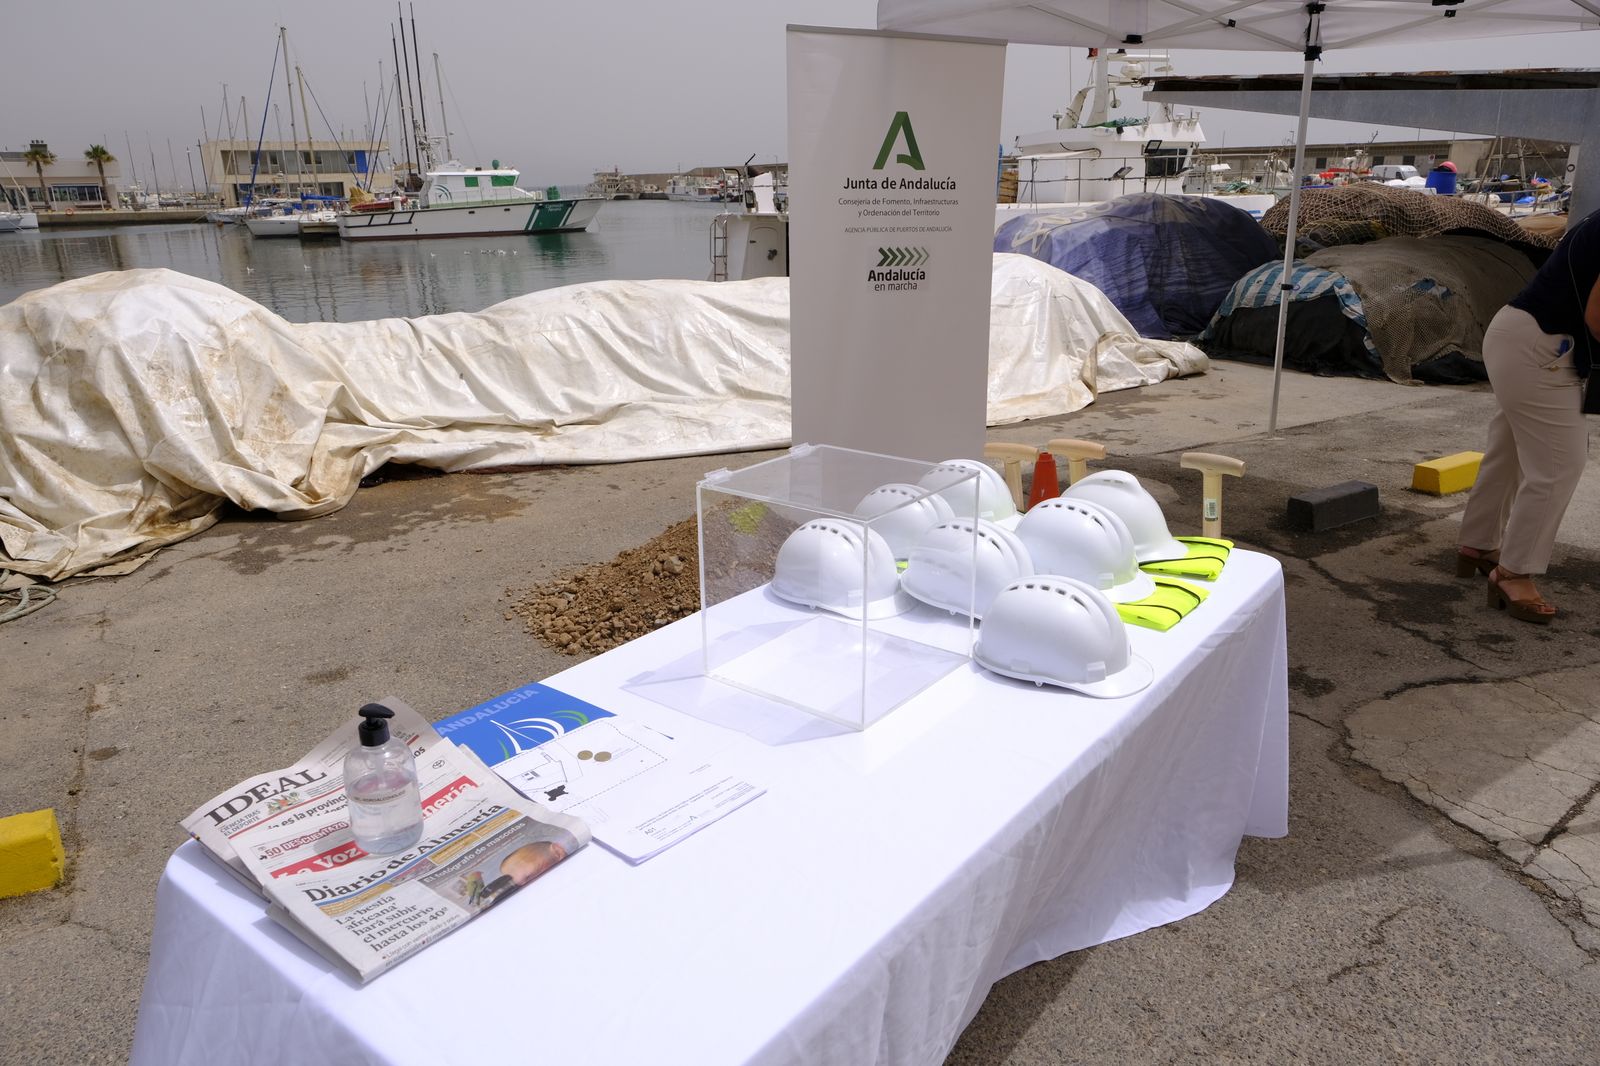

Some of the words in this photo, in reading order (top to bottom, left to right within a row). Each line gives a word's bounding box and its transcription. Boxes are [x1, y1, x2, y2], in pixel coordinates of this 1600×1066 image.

[843, 177, 878, 190] Junta
[881, 176, 897, 190] de
[899, 176, 956, 190] Andalucía
[863, 208, 901, 217] Ordenación
[901, 208, 912, 216] del
[912, 208, 941, 217] Territorio
[871, 197, 881, 205] de
[882, 197, 912, 206] Fomento,
[913, 197, 959, 206] Infraestructuras
[867, 268, 926, 282] Andalucía
[874, 283, 886, 292] en
[887, 281, 918, 291] marcha
[204, 769, 328, 826] IDEAL
[295, 810, 306, 821] la
[306, 794, 348, 817] provinci
[220, 818, 245, 833] CIENCIA
[244, 810, 261, 820] TRAS
[232, 816, 260, 832] DEPORTE
[302, 869, 387, 902] Diario
[387, 853, 417, 869] de
[417, 805, 504, 854] Almería
[423, 874, 436, 883] El
[436, 853, 475, 878] fotógrafo
[475, 845, 487, 855] de
[486, 822, 527, 848] mascotas
[336, 916, 355, 926] La
[352, 919, 386, 936] hará
[386, 905, 418, 922] subir
[363, 933, 377, 943] el
[377, 907, 434, 936] mercurio
[370, 929, 409, 952] hasta
[406, 920, 428, 933] los
